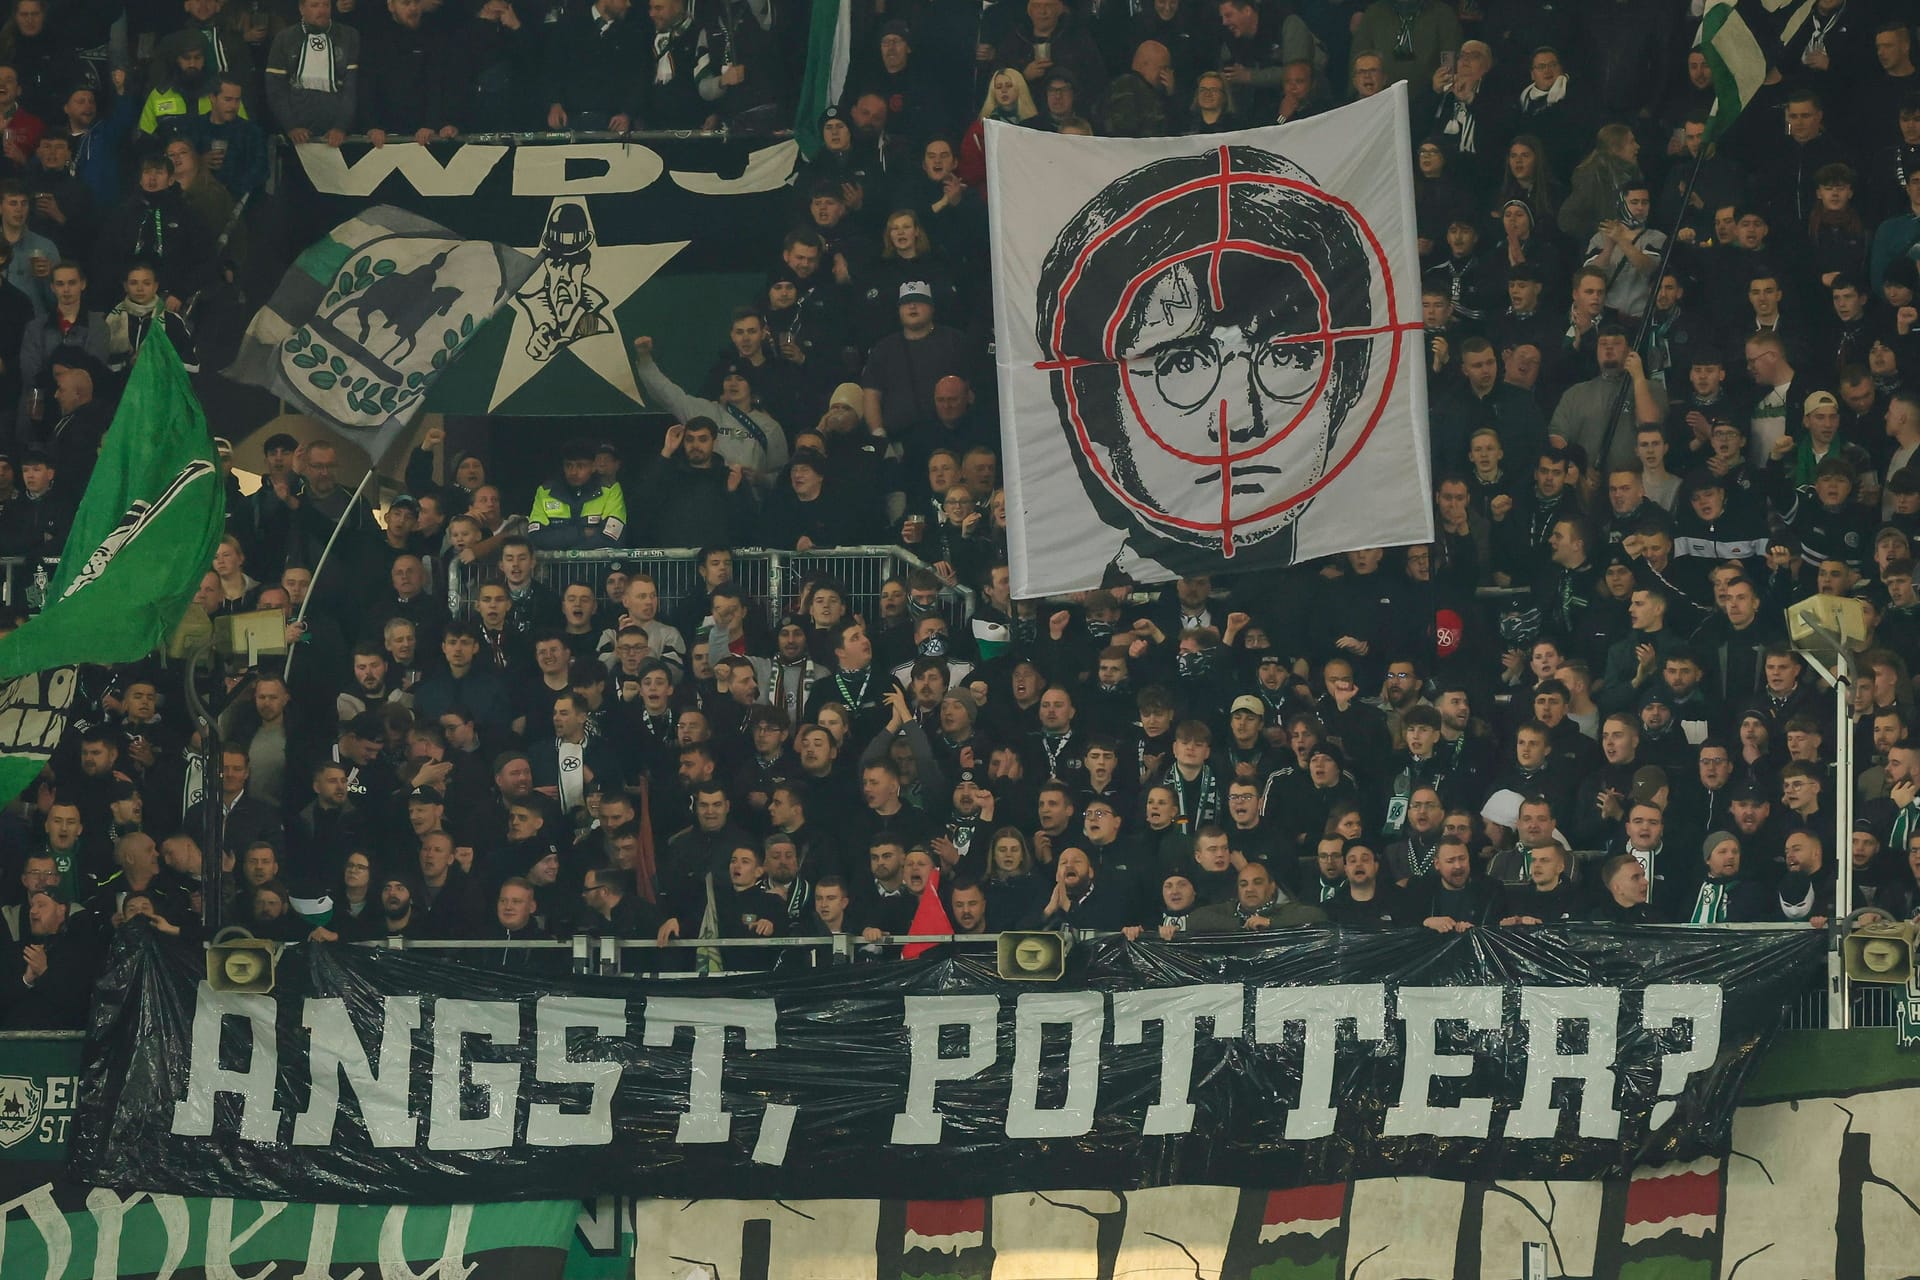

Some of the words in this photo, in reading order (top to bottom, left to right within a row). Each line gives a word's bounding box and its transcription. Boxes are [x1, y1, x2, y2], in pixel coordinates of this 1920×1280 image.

[293, 140, 800, 197] WDJ
[1437, 628, 1452, 646] 96
[928, 640, 941, 653] 96
[562, 757, 580, 771] 96
[1389, 804, 1405, 819] 96
[171, 979, 798, 1166] ANGST,
[891, 983, 1723, 1145] POTTER?
